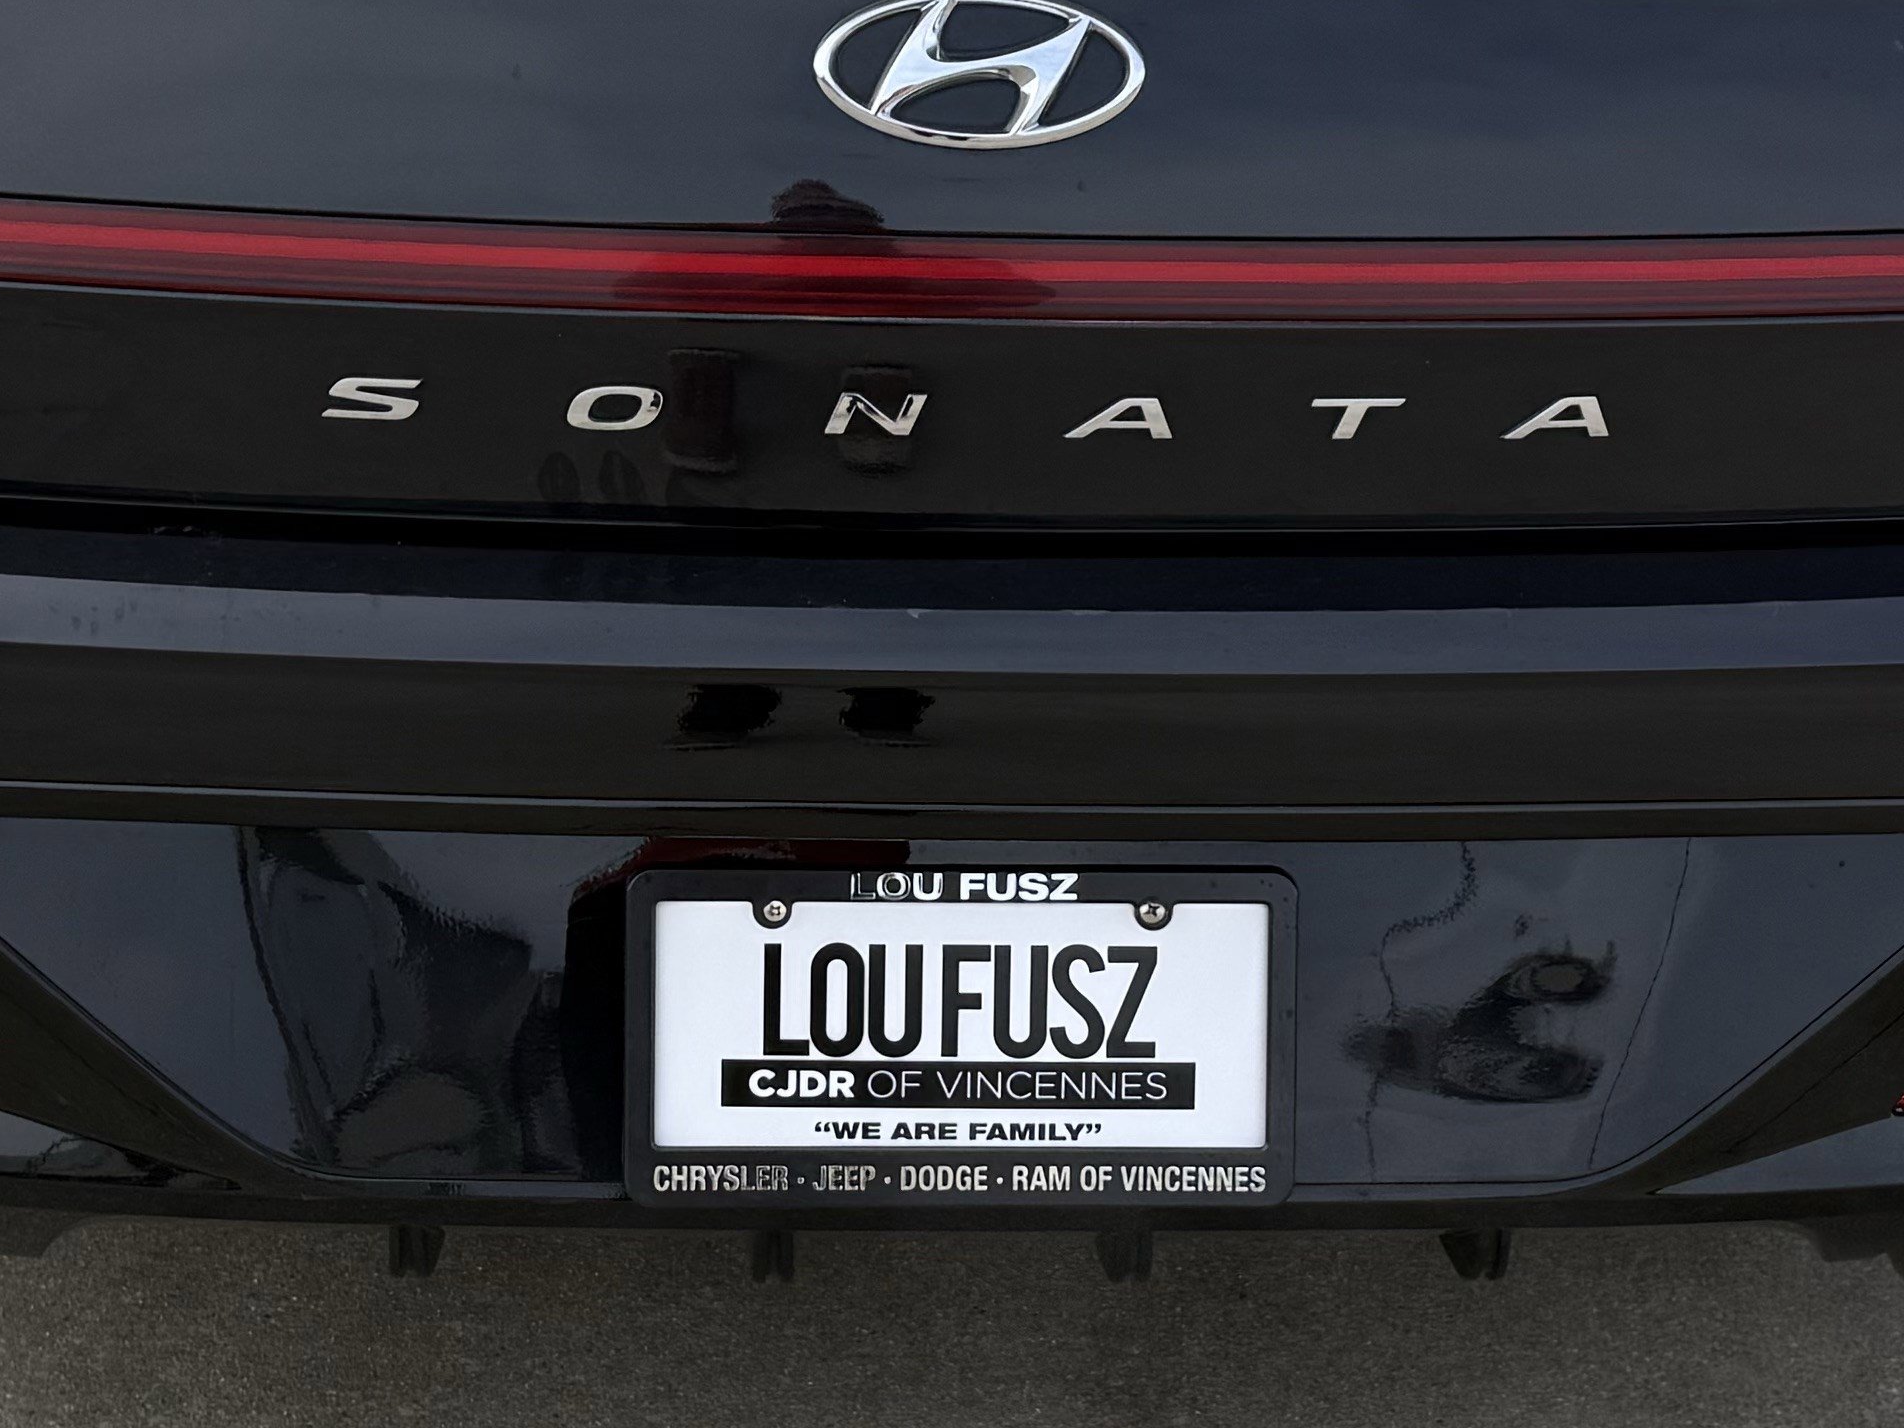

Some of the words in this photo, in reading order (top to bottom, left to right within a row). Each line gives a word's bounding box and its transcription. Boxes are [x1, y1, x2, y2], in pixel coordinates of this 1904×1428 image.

[321, 377, 1610, 440] SONATA
[850, 872, 944, 901] LOU
[959, 872, 1079, 901] FUSZ
[762, 942, 924, 1058] LOU
[940, 943, 1159, 1060] FUSZ
[748, 1068, 855, 1099] CJDR
[867, 1070, 923, 1099] OF
[936, 1070, 1169, 1101] VINCENNES
[890, 1122, 958, 1141] ARE
[653, 1164, 789, 1193] CHRYSLER
[812, 1164, 876, 1193] JEEP
[900, 1165, 989, 1193] DODGE
[1012, 1165, 1072, 1193] RAM
[1079, 1165, 1113, 1193] OF
[1120, 1165, 1267, 1194] VINCENNES
